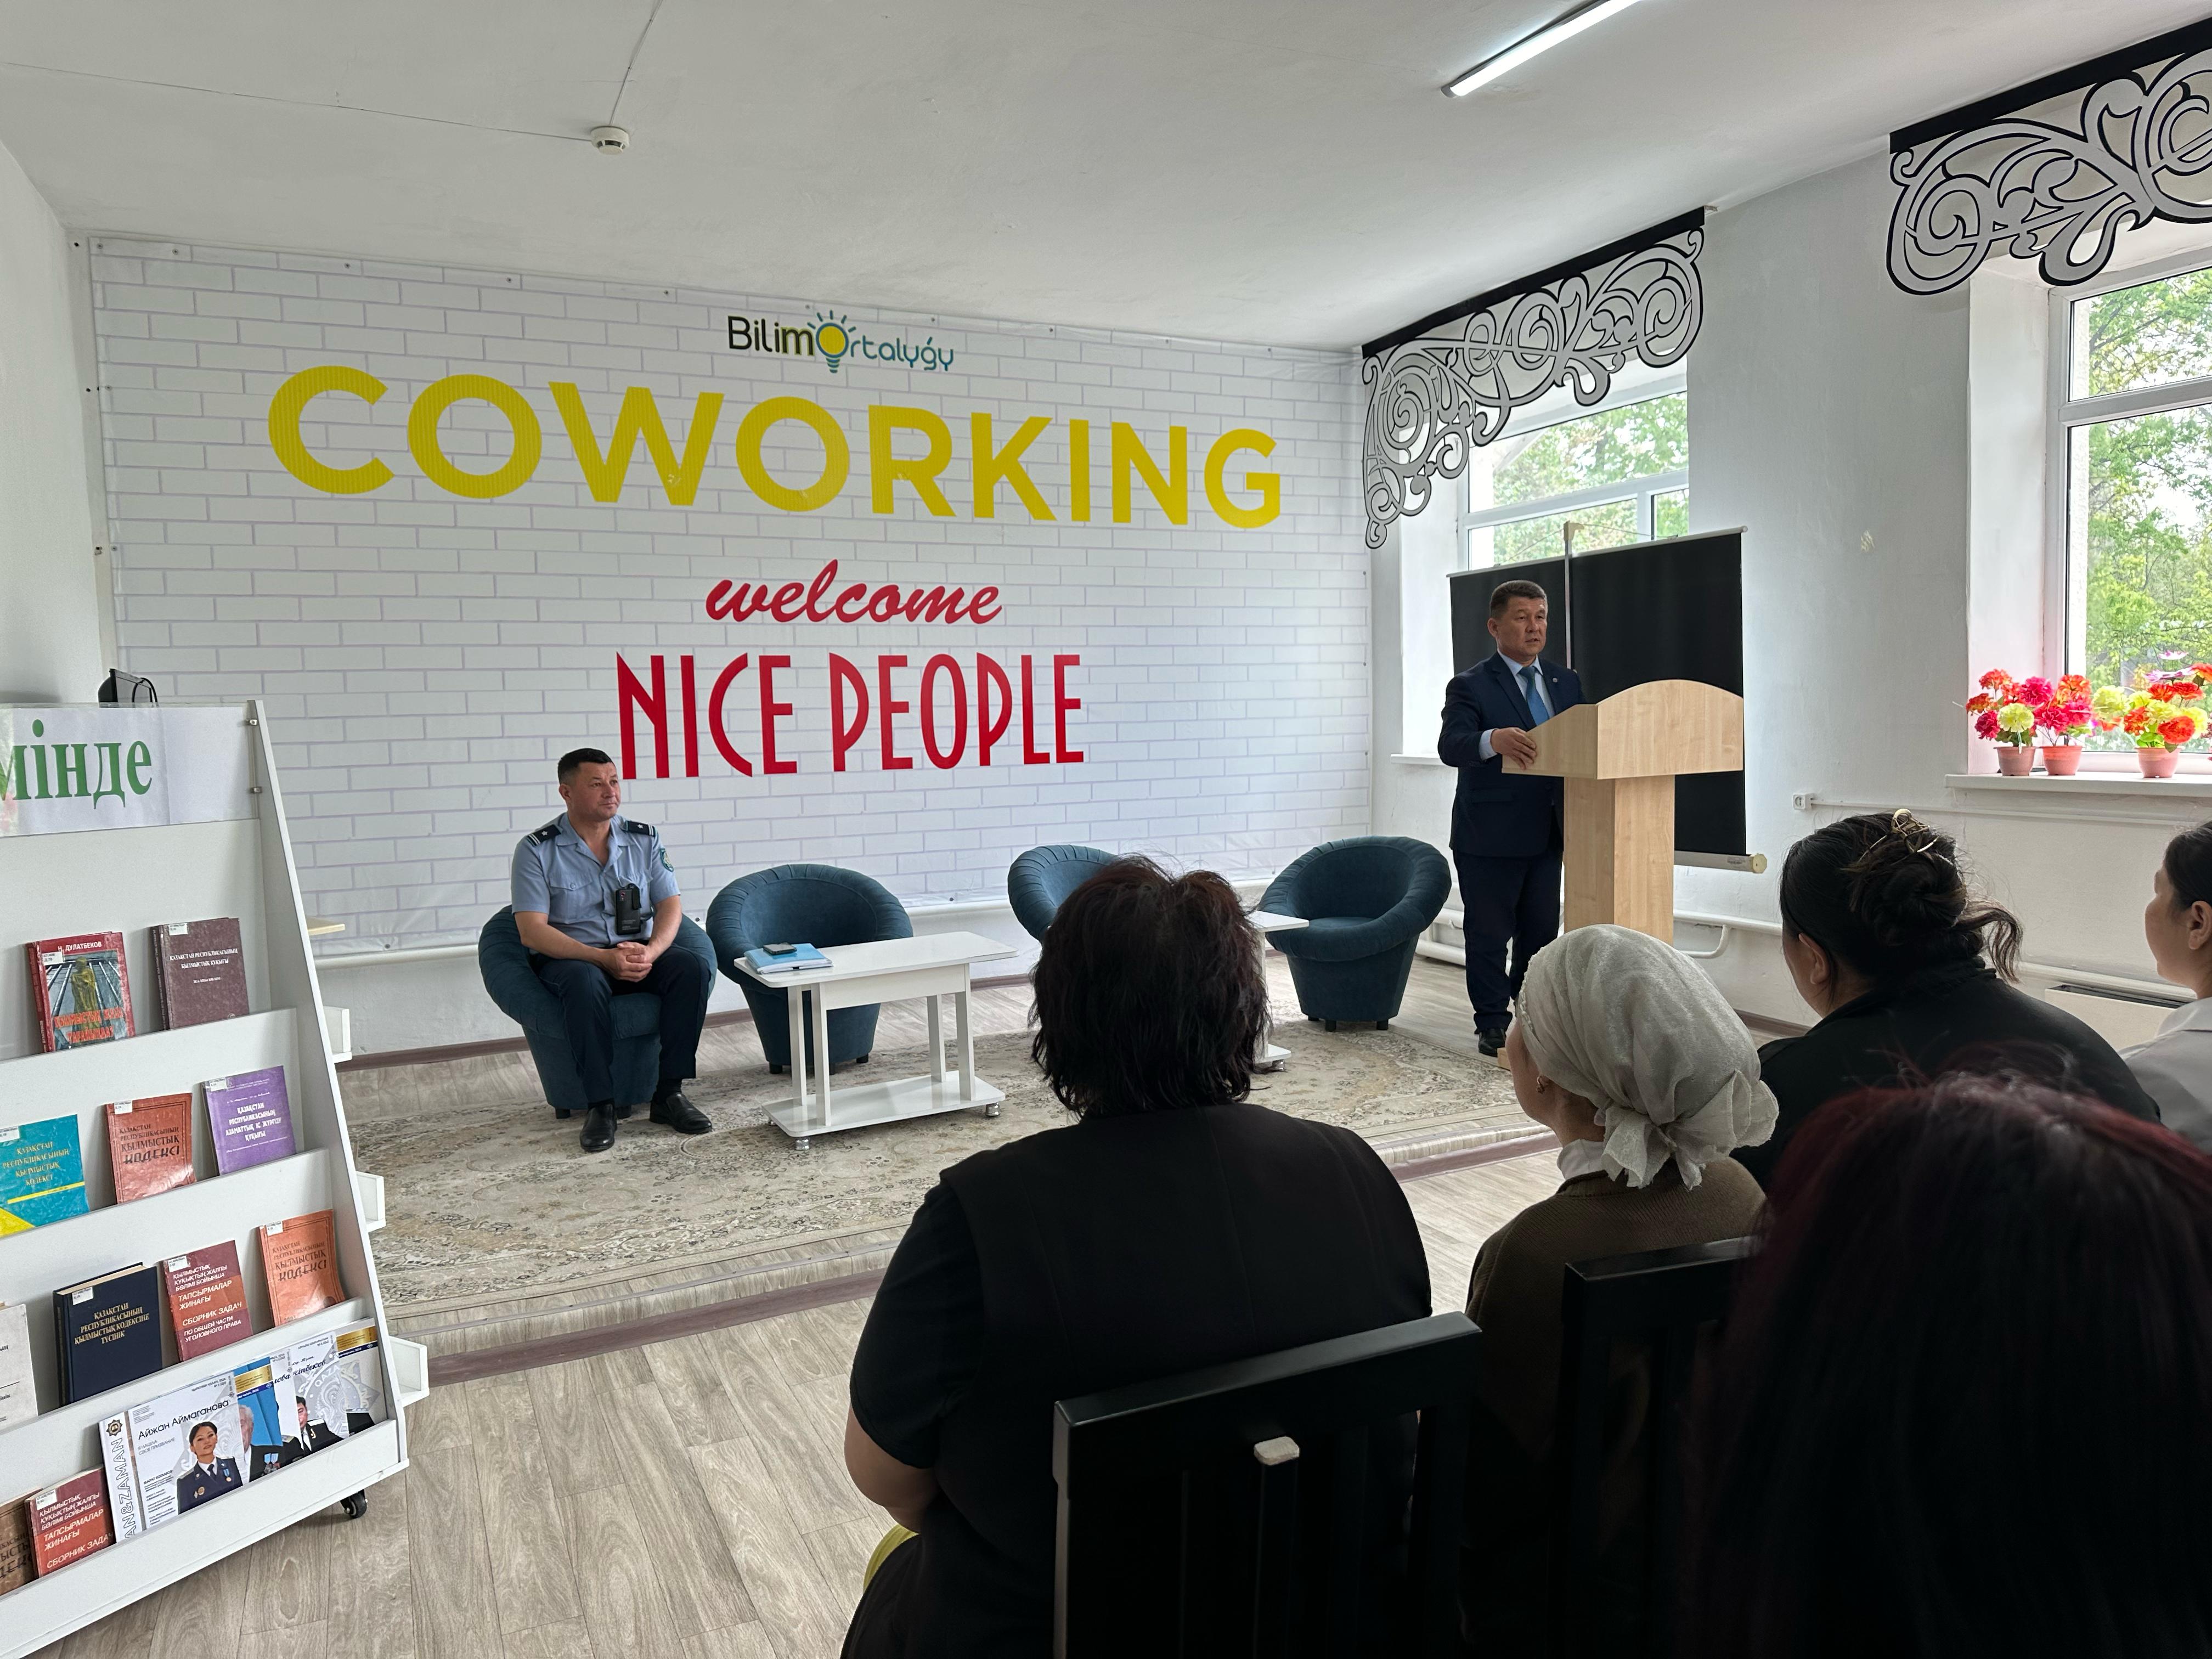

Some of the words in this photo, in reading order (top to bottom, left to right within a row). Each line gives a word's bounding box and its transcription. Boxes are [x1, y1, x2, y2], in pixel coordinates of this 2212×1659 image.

[268, 365, 1280, 528] COWORKING
[706, 559, 1002, 624] welcome
[617, 651, 797, 780] NICE
[829, 653, 1084, 772] PEOPLE
[65, 941, 102, 952] ДУЛАТБЕКОВ
[179, 1280, 232, 1302] ТАПСЫРМАЛАР
[182, 1310, 217, 1326] СБОРНИК
[218, 1301, 242, 1315] ЗАДАЧ
[193, 1321, 215, 1333] ОБЩЕЙ
[216, 1316, 233, 1325] ЧАСТИ
[185, 1325, 222, 1342] УГОЛОВНОГО
[223, 1319, 241, 1329] ПРАВА
[138, 1421, 170, 1441] Айжан
[171, 1400, 229, 1427] Аймаганова
[76, 1492, 99, 1508] ЖАЛПЫ
[43, 1509, 104, 1542] ТАПСЫРМАЛАР
[47, 1544, 86, 1569] СБОРНИК
